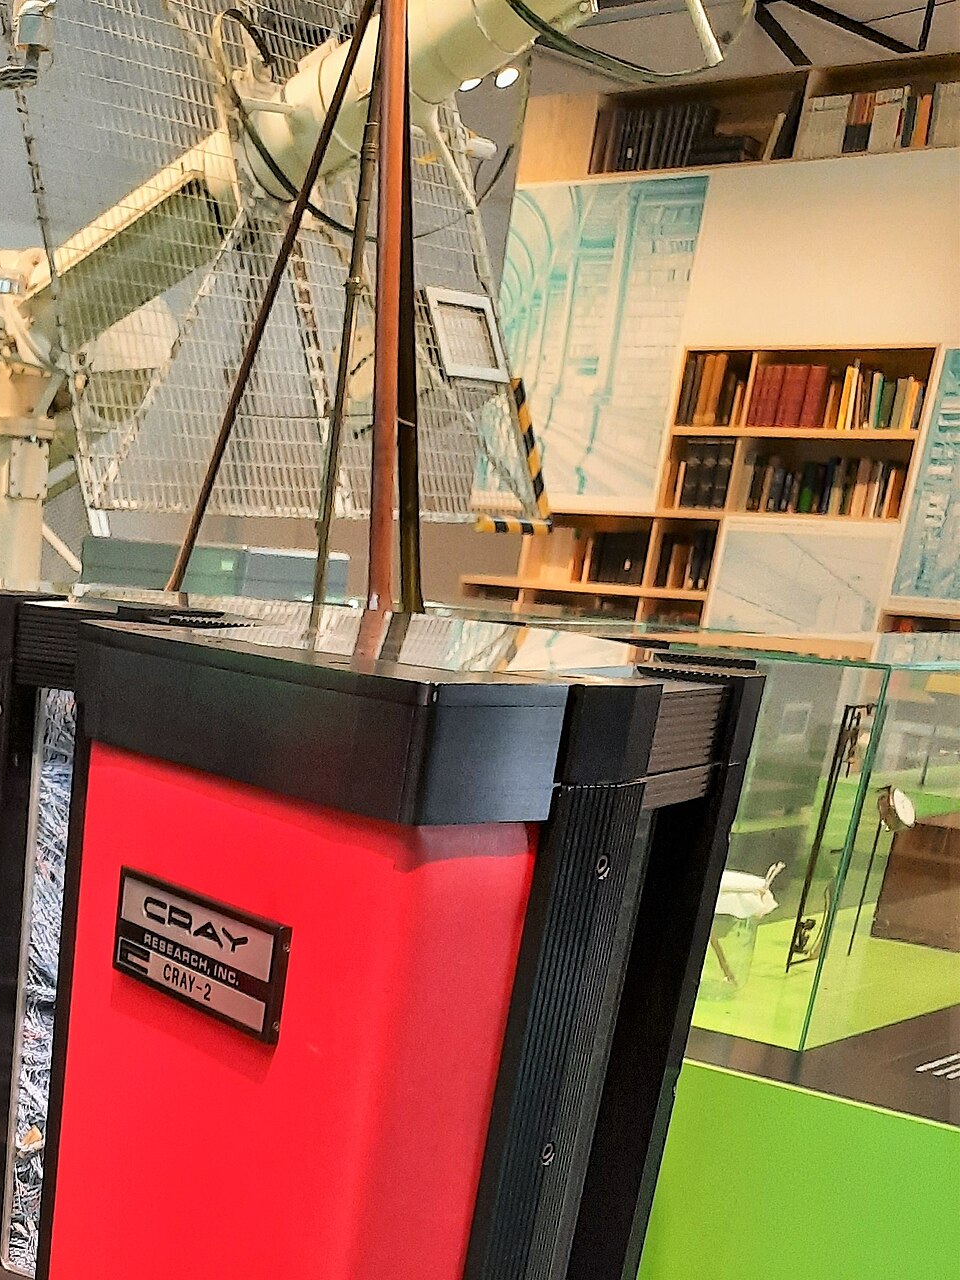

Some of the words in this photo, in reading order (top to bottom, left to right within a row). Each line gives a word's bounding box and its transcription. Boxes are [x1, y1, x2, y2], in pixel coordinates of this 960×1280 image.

[143, 896, 249, 952] CRAY
[143, 932, 211, 975] RESEARCH,
[213, 964, 240, 986] INC.
[162, 963, 212, 1002] CRAY-2
